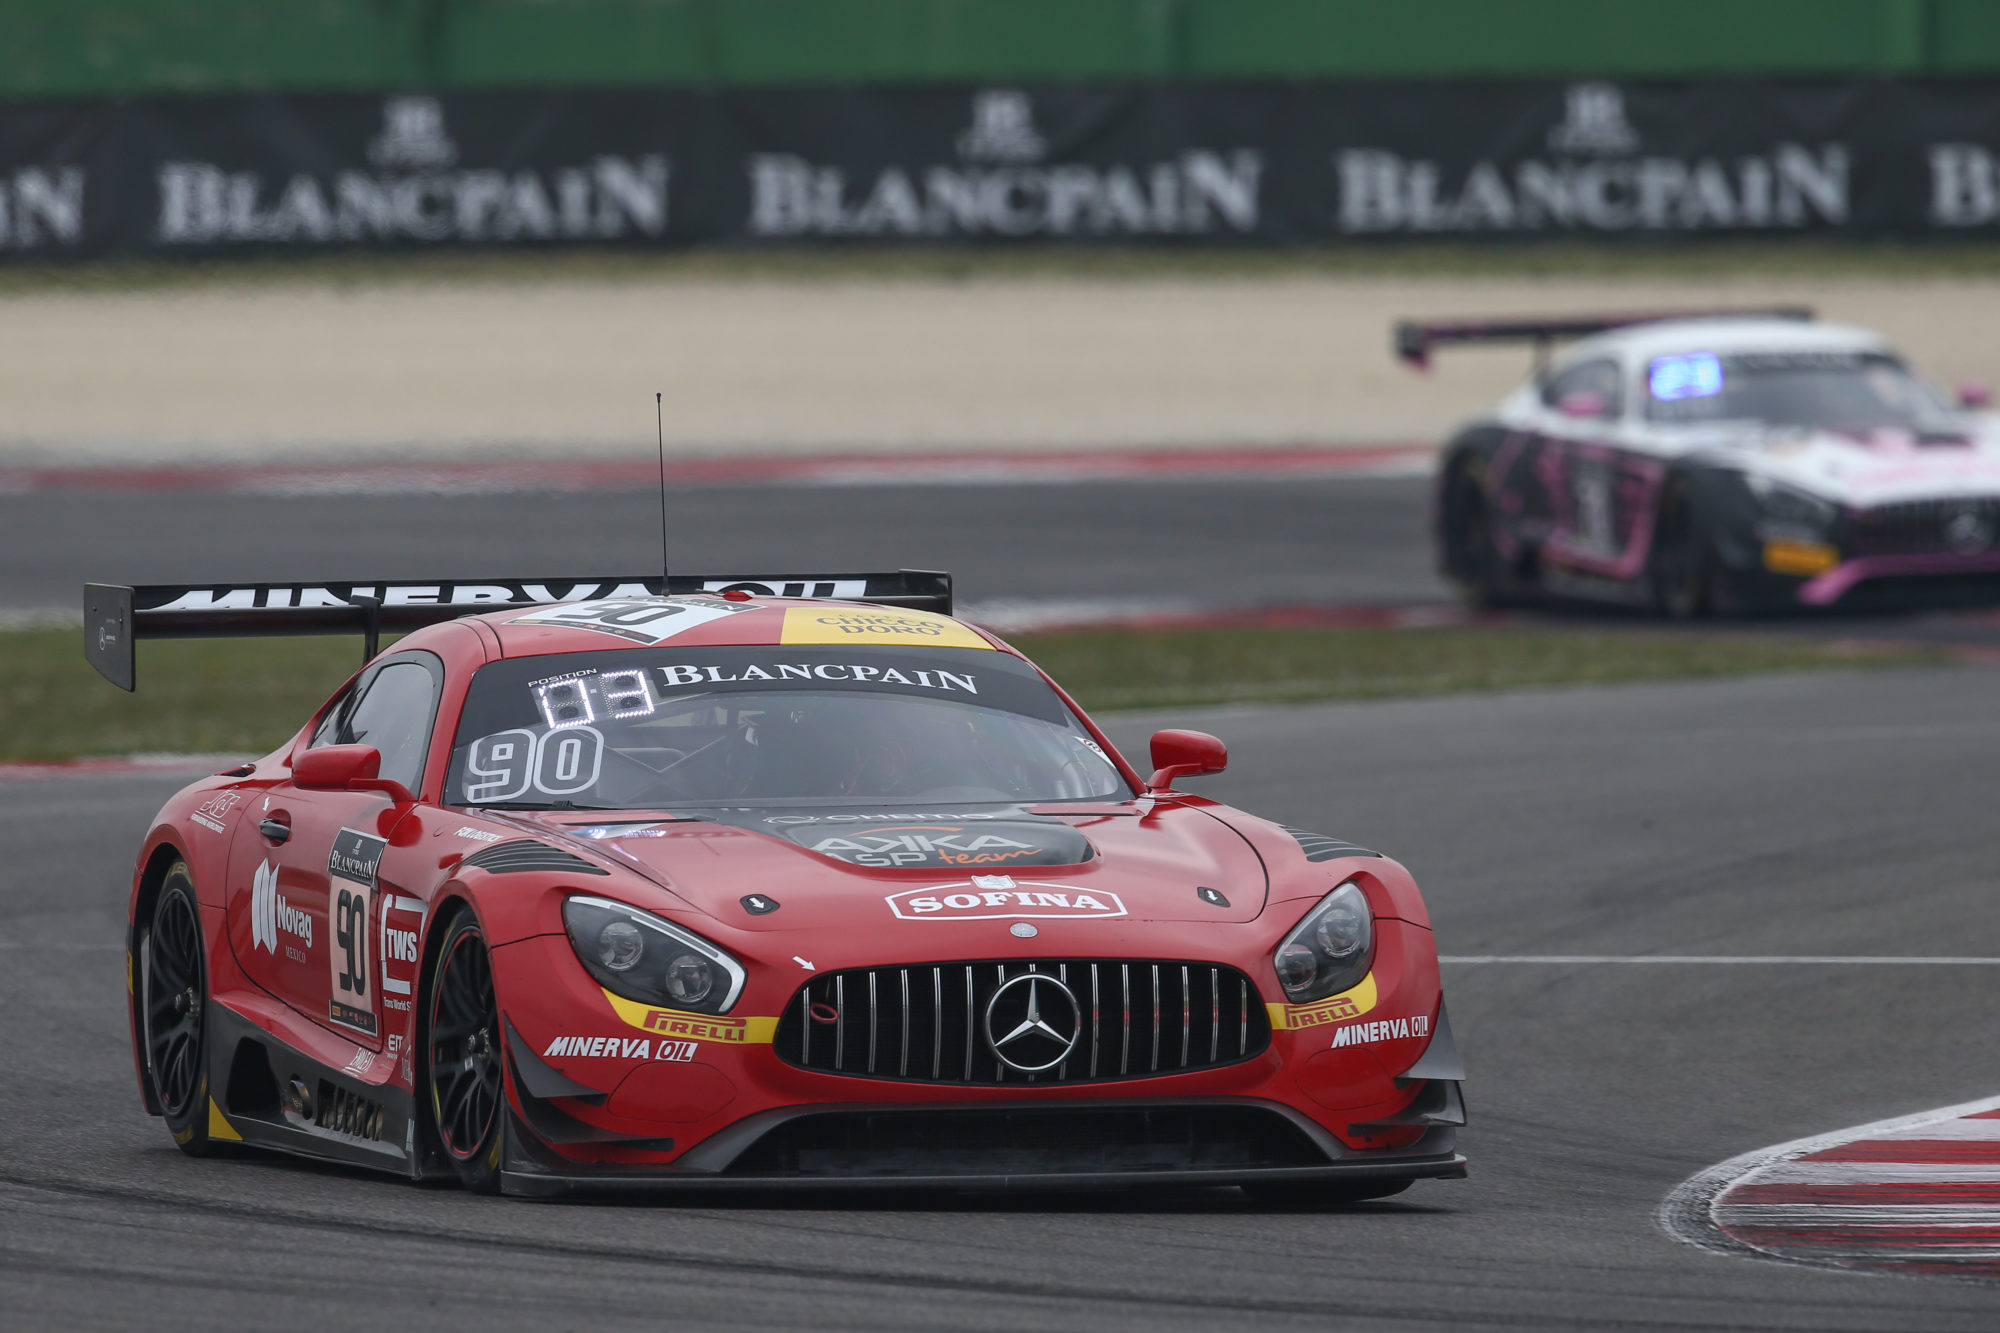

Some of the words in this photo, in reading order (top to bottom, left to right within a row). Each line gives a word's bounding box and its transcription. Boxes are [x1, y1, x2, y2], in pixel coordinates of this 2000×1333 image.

[157, 155, 668, 243] BLANCPAIN
[749, 148, 1263, 235] BLANCPAIN
[1335, 142, 1850, 232] BLANCPAIN
[816, 616, 944, 629] CHICCO
[528, 668, 598, 688] POSITION
[657, 664, 978, 695] BLANCPAIN
[466, 725, 605, 803] 90
[807, 834, 1036, 852] AKKA
[938, 848, 1043, 864] team
[331, 850, 376, 878] BLANCPAIN
[908, 891, 1110, 914] SOFINA
[277, 894, 312, 948] Novag
[336, 888, 366, 996] 90
[386, 928, 418, 963] TWS
[643, 1010, 748, 1042] PIRELLI
[1284, 997, 1360, 1027] PIRELLI
[1331, 1018, 1410, 1049] MINERVA
[1412, 1016, 1428, 1037] OIL
[543, 1036, 650, 1060] MINERVA
[657, 1041, 697, 1062] OIL
